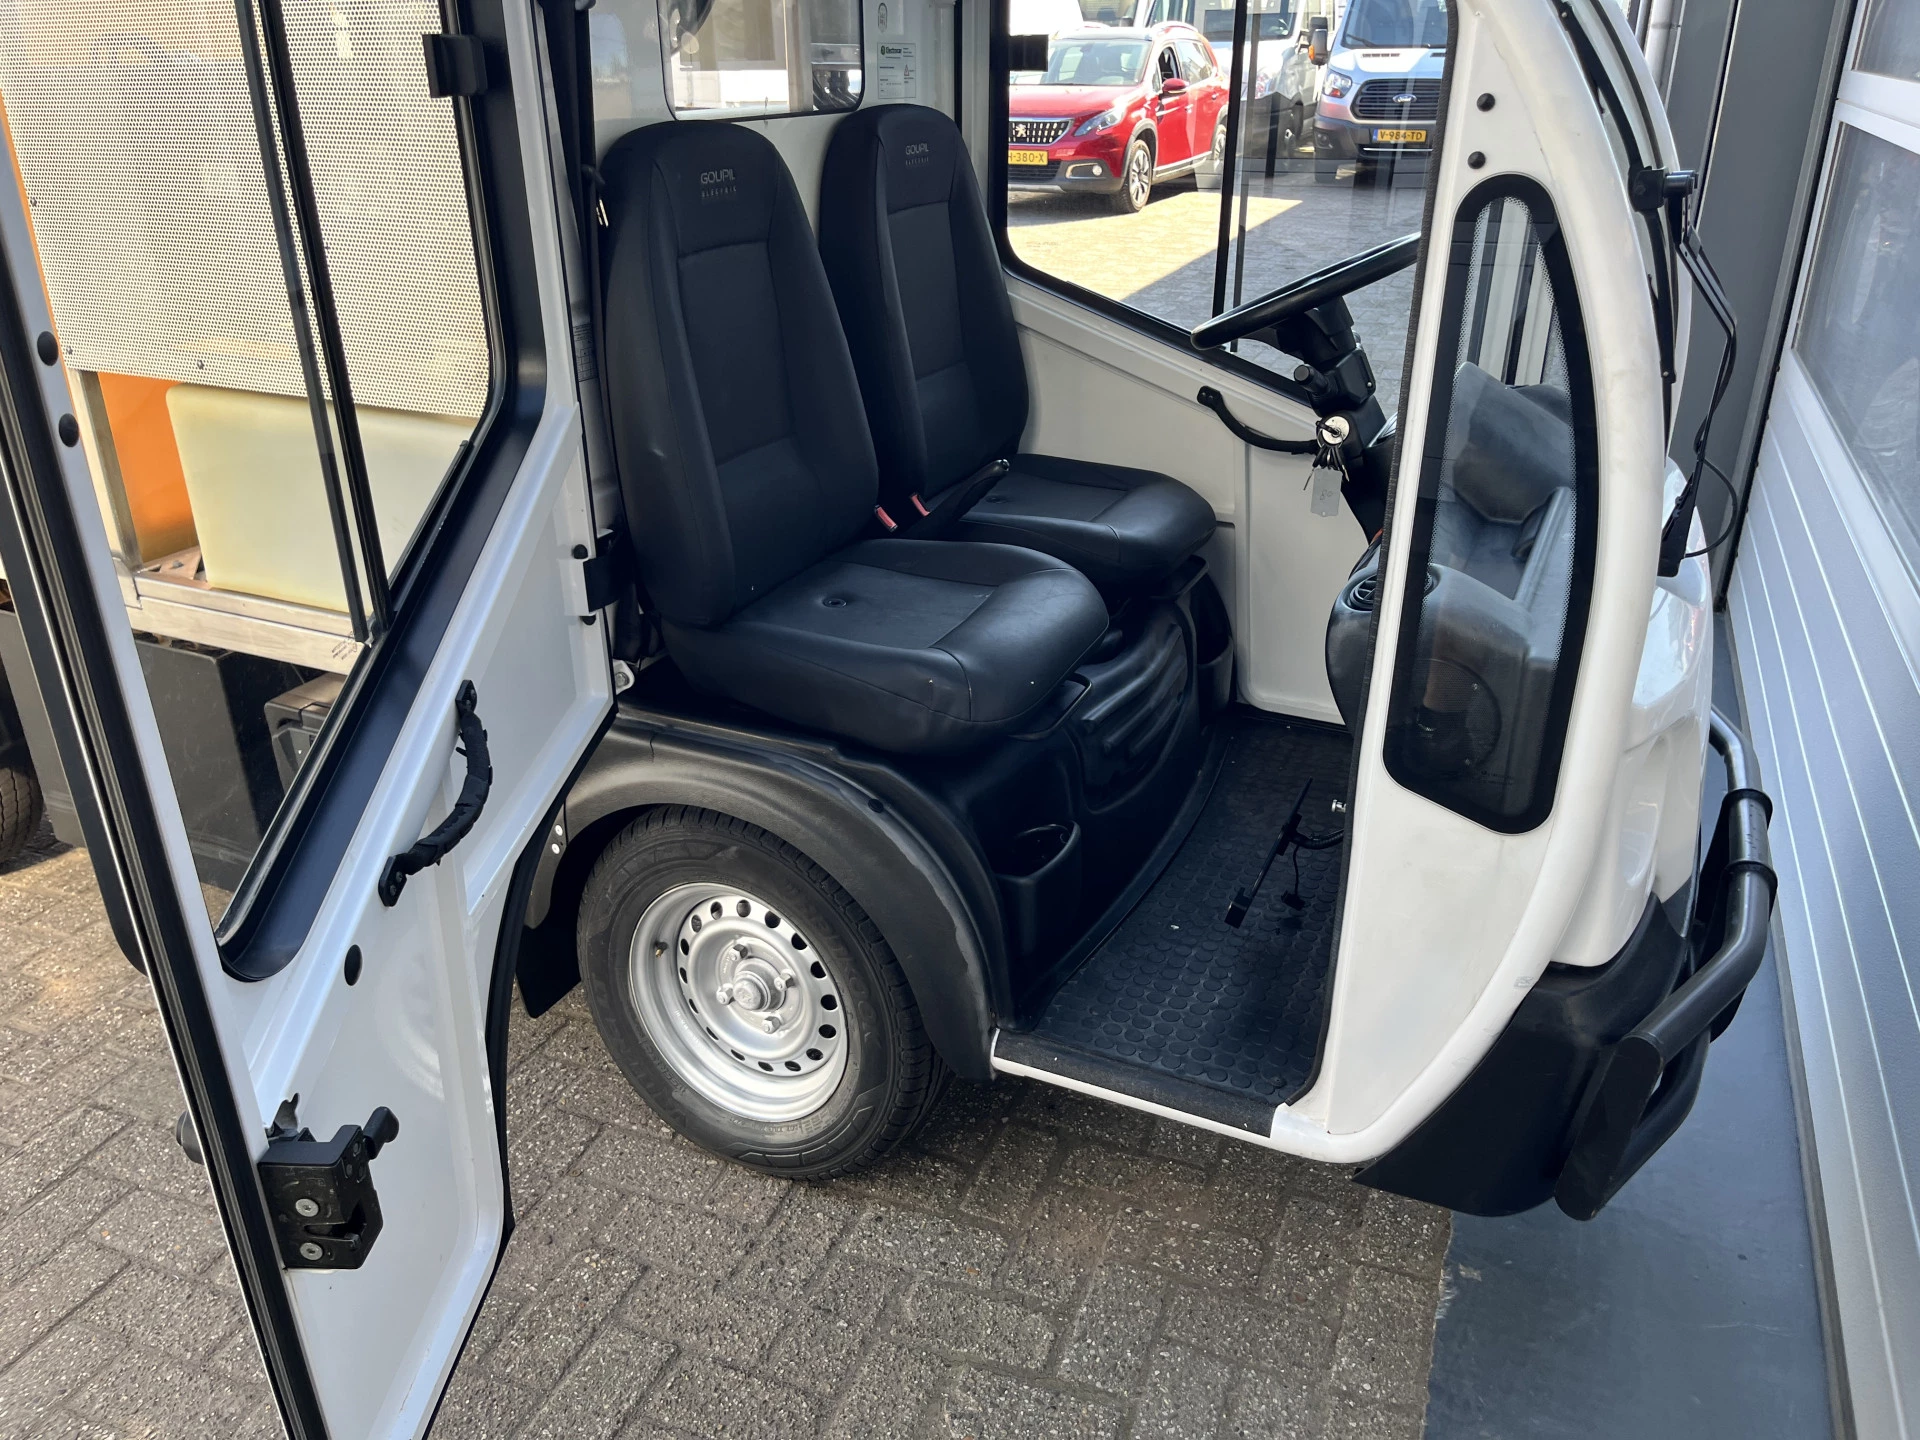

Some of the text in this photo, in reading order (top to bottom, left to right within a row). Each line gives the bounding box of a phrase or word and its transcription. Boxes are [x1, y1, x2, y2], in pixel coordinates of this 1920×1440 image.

[1380, 131, 1423, 141] V-984-TD
[1008, 152, 1045, 163] H-380-X
[700, 168, 736, 184] GOUPIL
